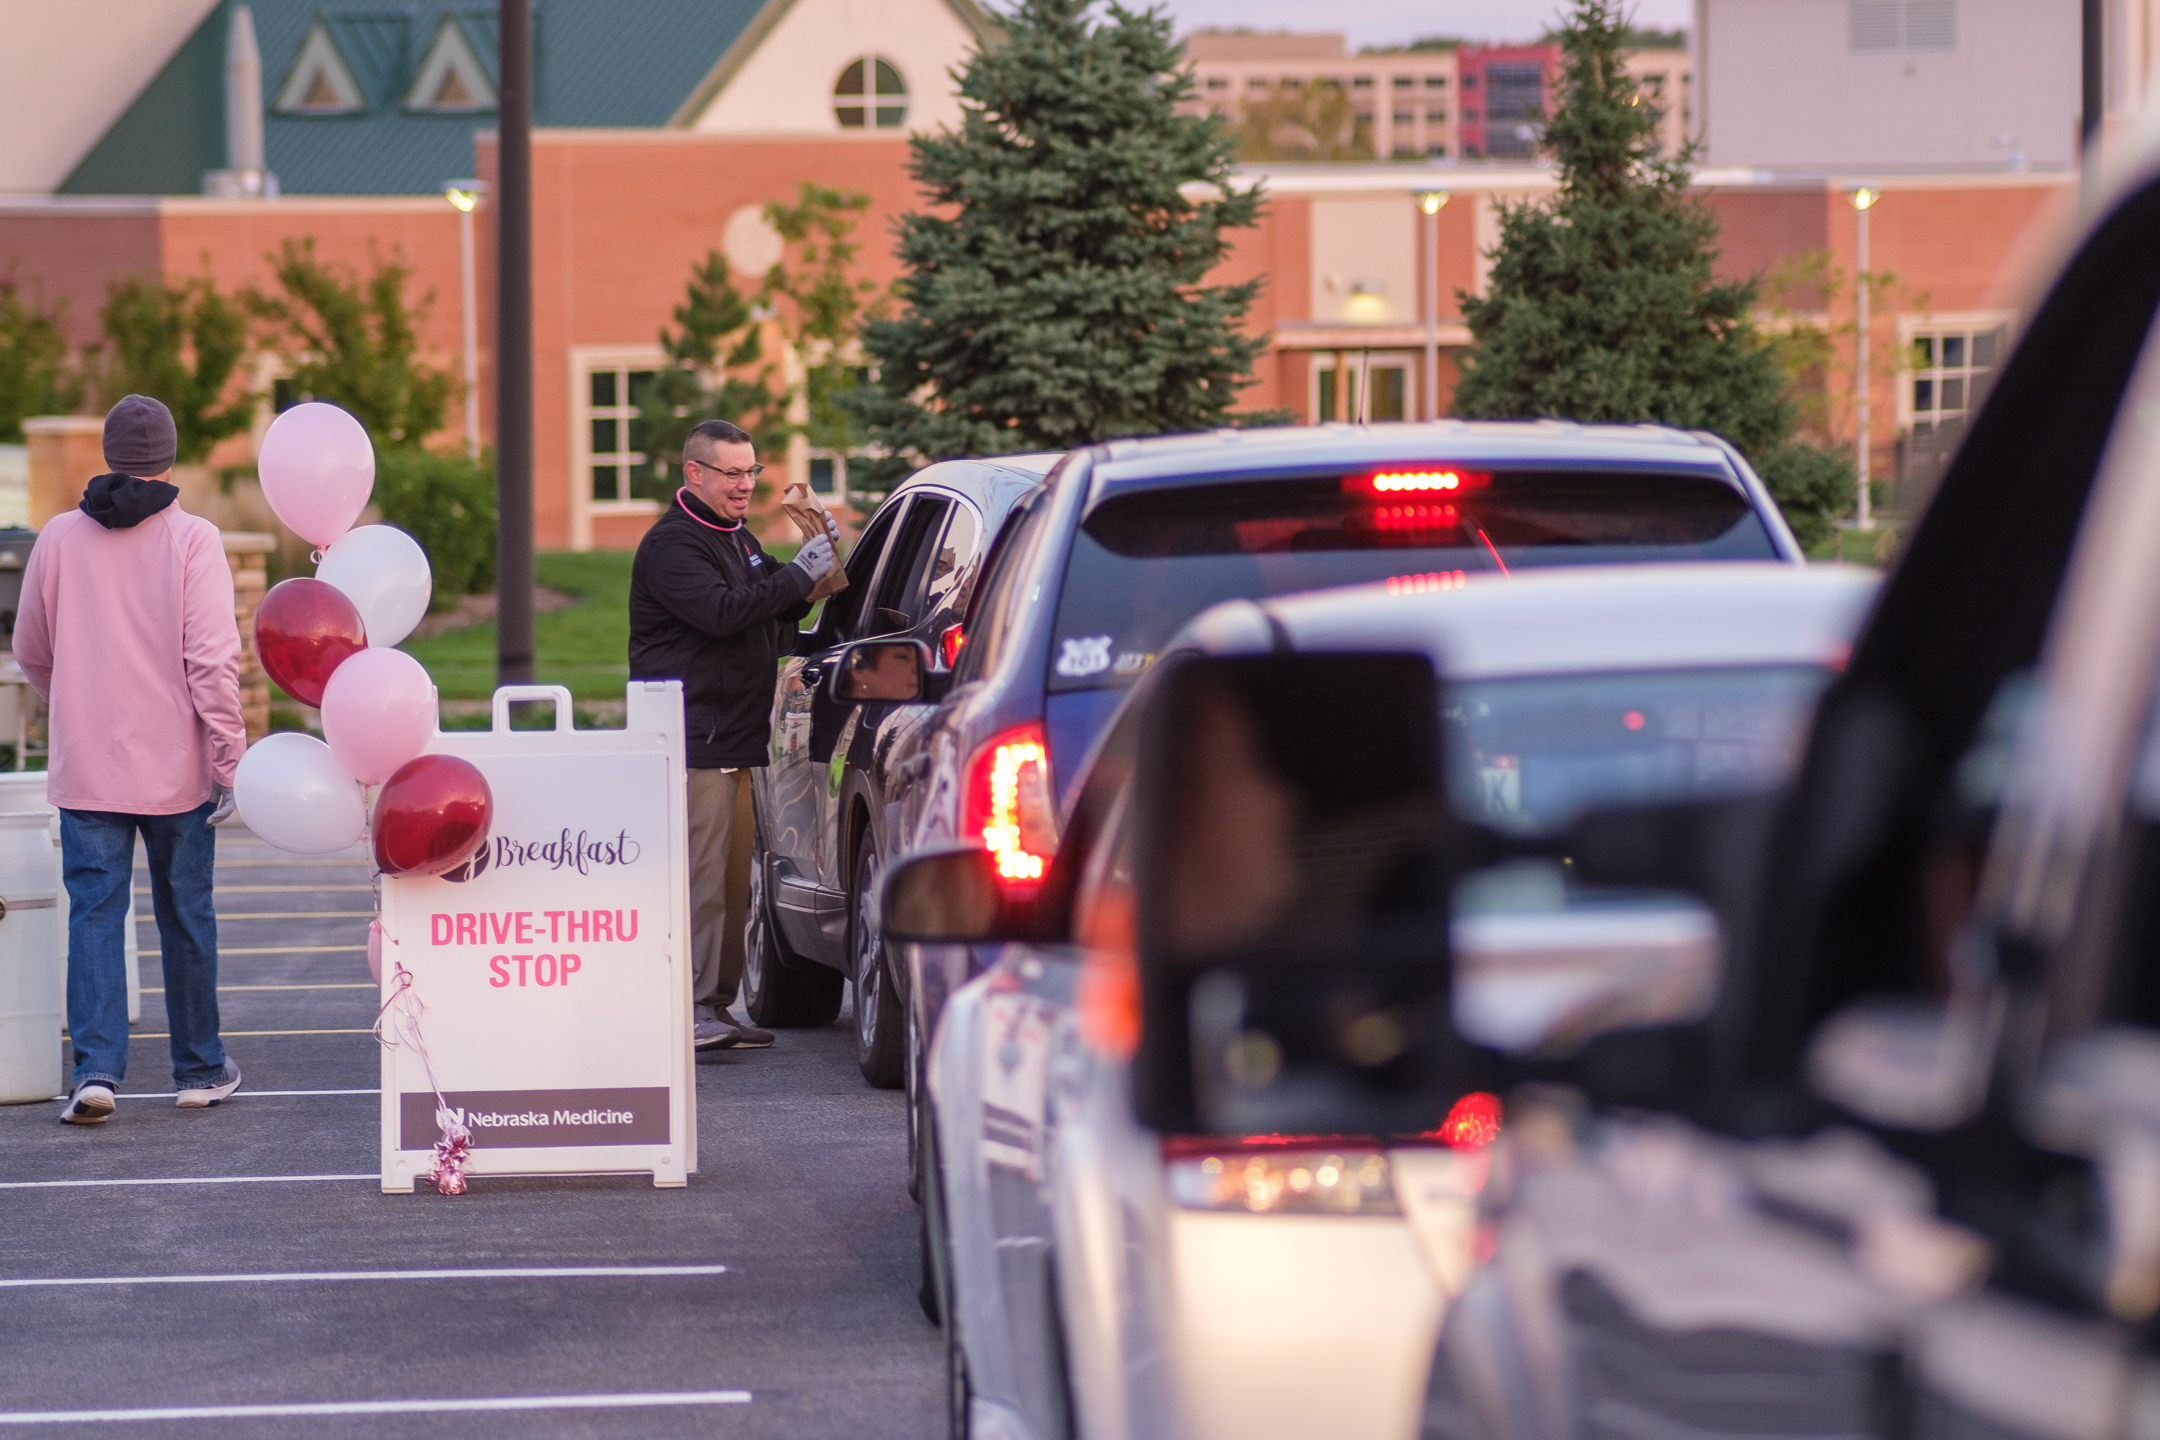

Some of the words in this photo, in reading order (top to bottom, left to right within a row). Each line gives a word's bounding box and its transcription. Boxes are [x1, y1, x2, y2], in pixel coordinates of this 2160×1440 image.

[494, 827, 641, 876] Breakfast
[431, 909, 638, 946] DRIVE-THRU
[488, 953, 582, 988] STOP
[468, 1111, 550, 1128] Nebraska
[552, 1109, 634, 1126] Medicine
